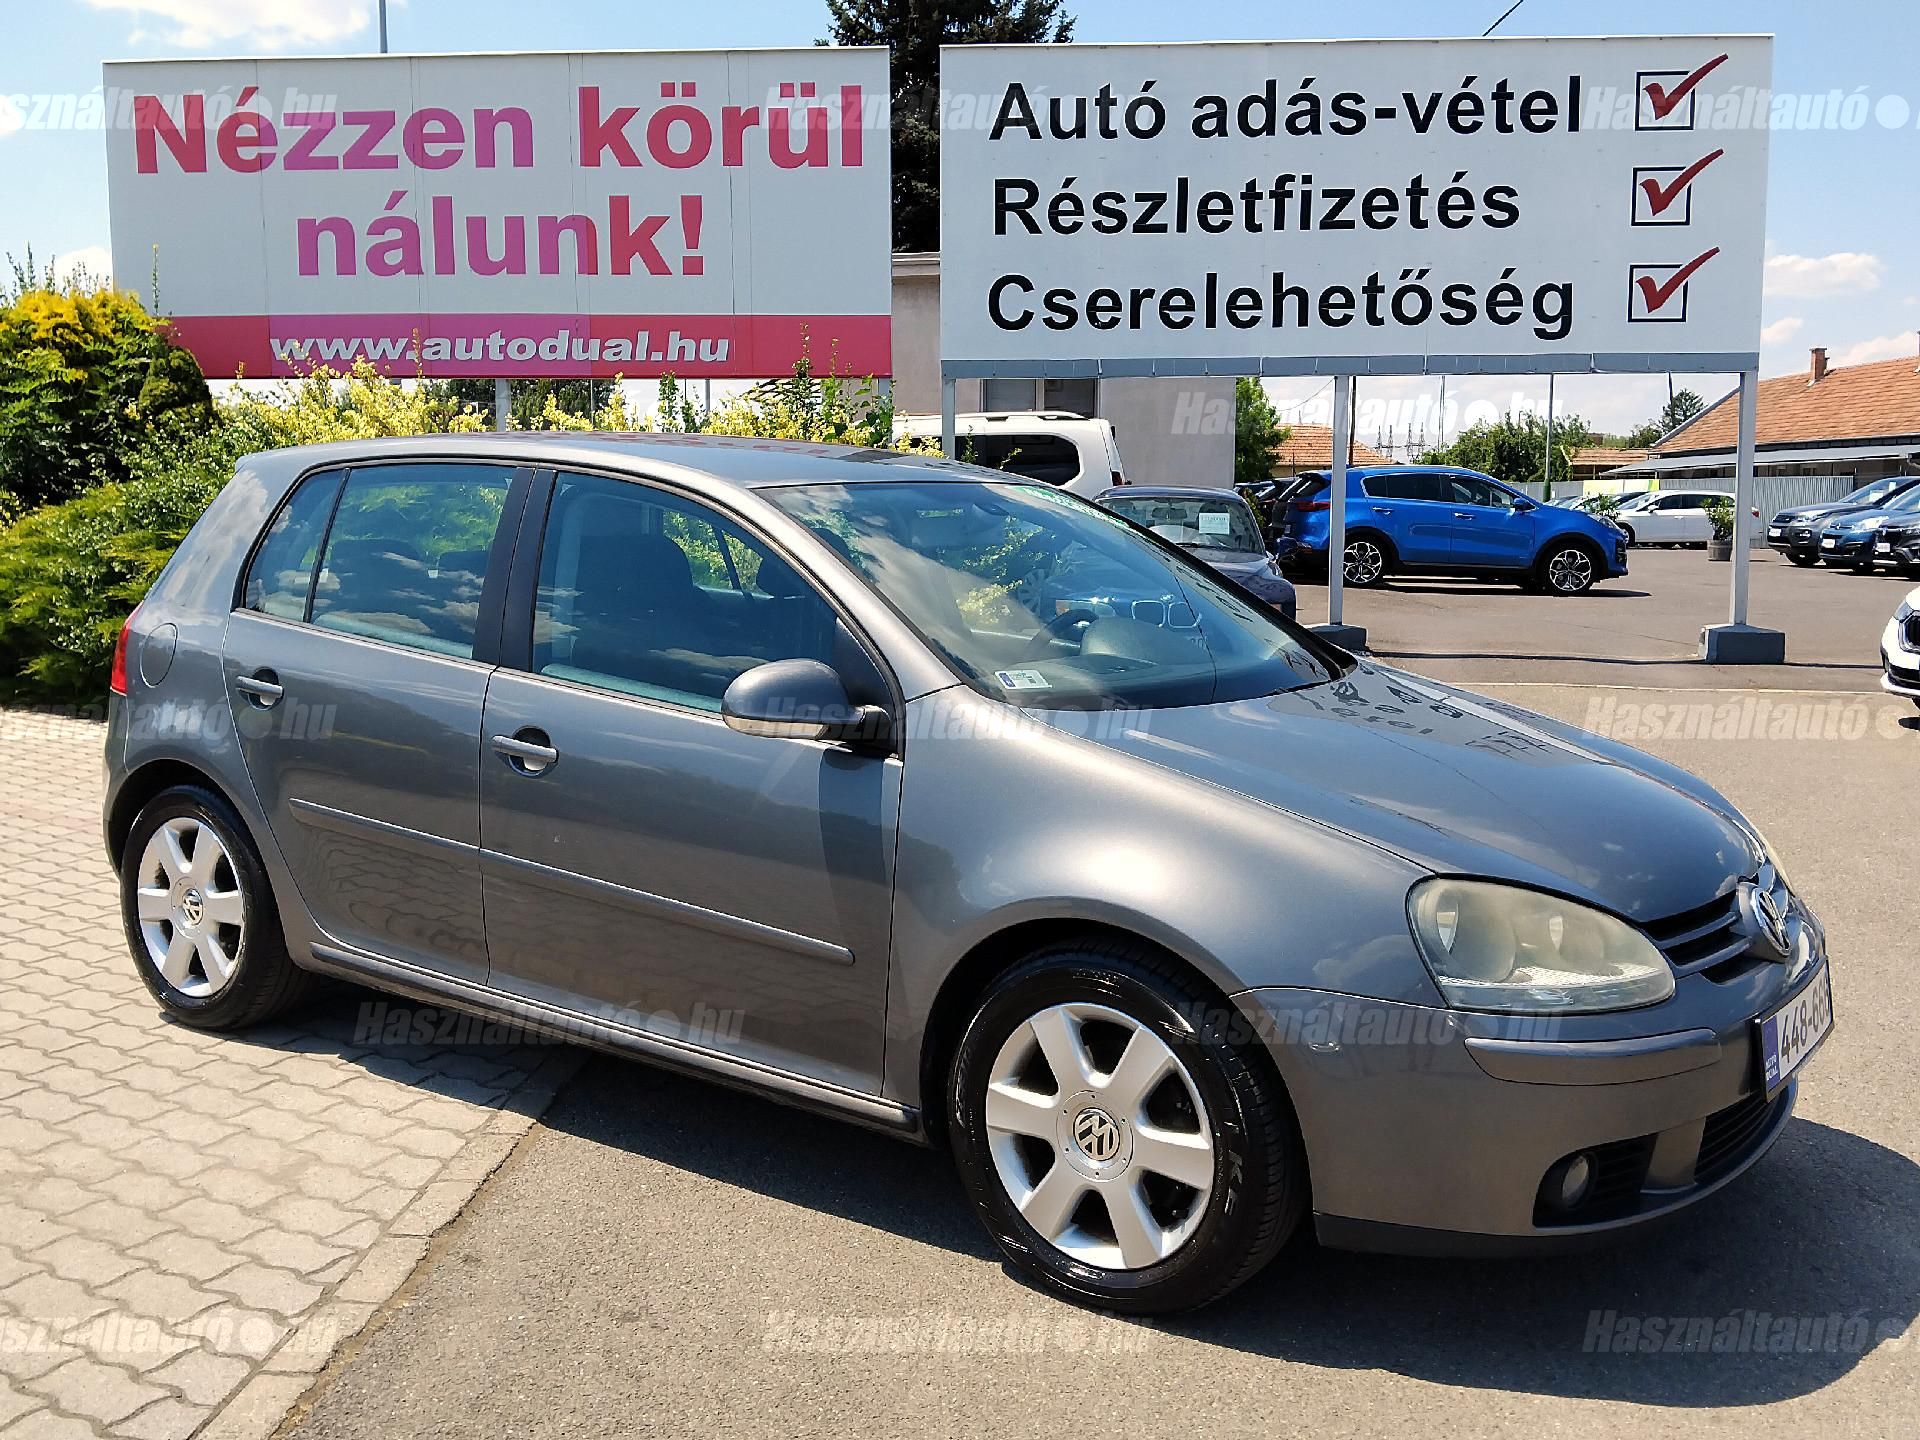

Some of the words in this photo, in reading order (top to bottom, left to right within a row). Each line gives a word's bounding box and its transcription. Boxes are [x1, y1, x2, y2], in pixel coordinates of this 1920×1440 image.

[133, 86, 535, 175] Nézzen
[577, 81, 865, 169] körül
[988, 79, 1167, 142] Autó
[1192, 75, 1584, 138] adás-vétel
[297, 190, 706, 278] nálunk!
[992, 170, 1521, 238] Részletfizetés
[985, 267, 1575, 341] Cserelehetőség
[269, 329, 729, 363] www.autodual.hu
